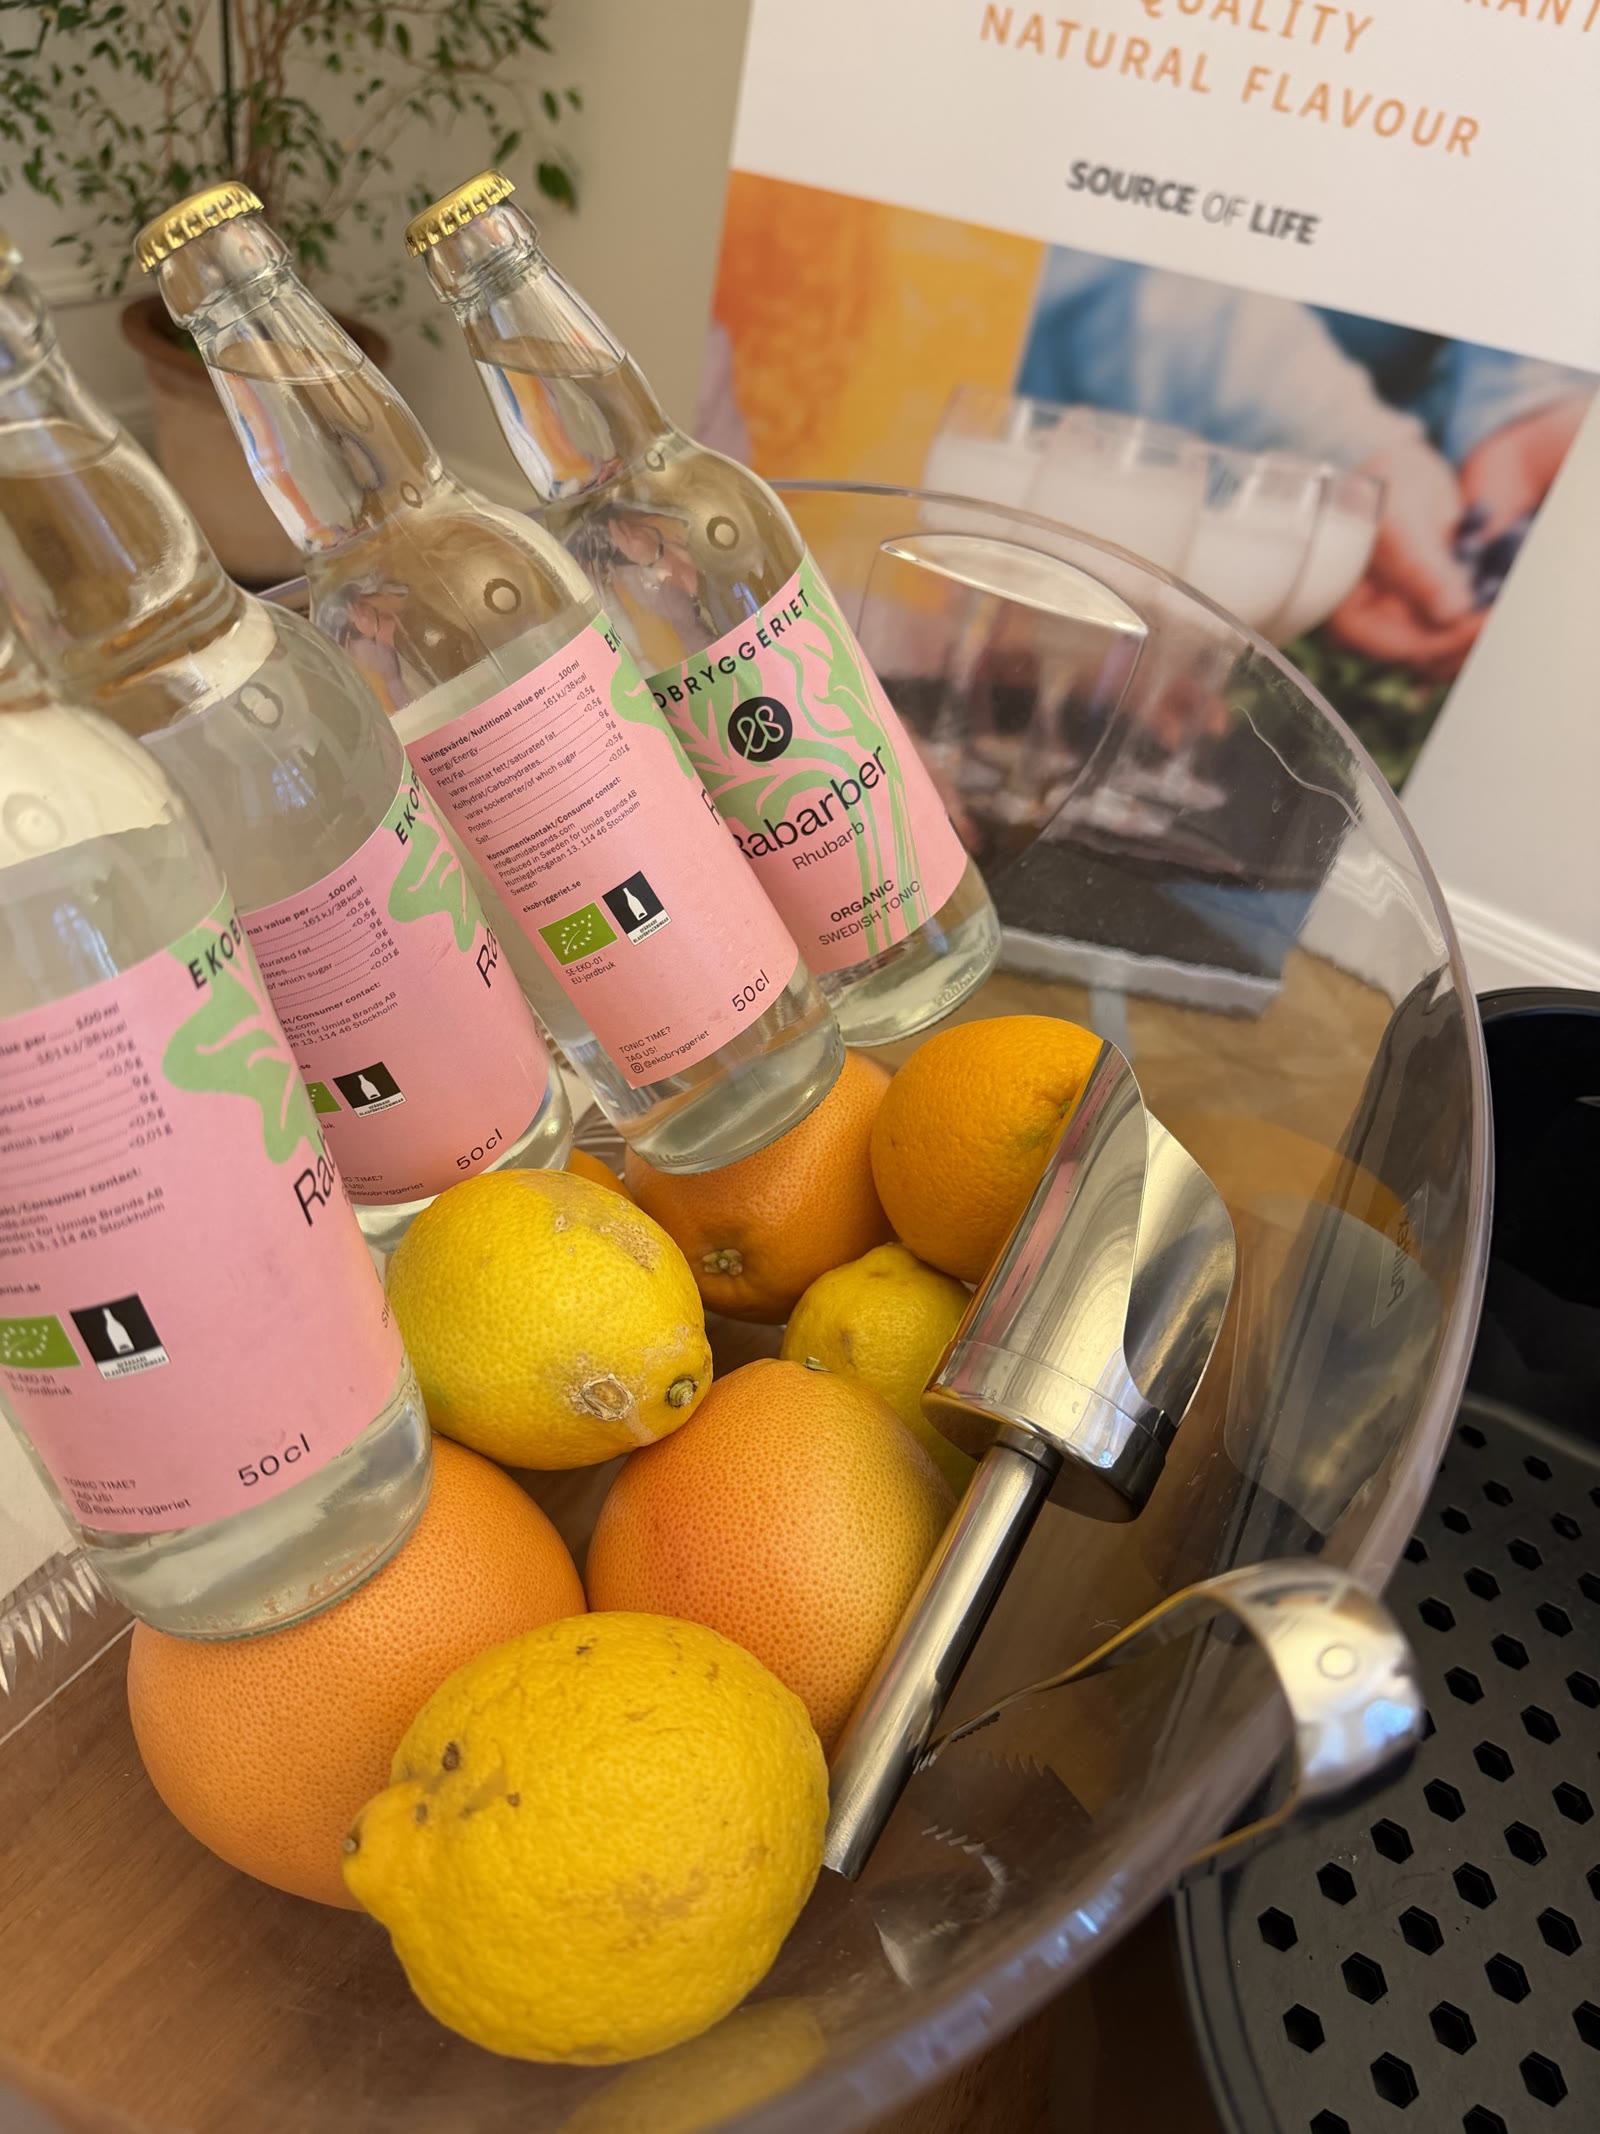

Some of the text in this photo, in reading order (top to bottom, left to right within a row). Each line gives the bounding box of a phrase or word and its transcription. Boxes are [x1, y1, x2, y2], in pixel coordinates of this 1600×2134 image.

[980, 4, 1481, 158] NATURAL FLAVOUR
[1066, 159, 1320, 246] SOURCE OF LIFE
[420, 708, 513, 763] Näringsvärde/Nutritional
[512, 696, 534, 713] value
[534, 686, 546, 699] per
[428, 747, 479, 775] Energi/Energy
[449, 785, 468, 797] varav
[469, 771, 493, 788] mättat
[492, 739, 545, 774] fett/saturated
[544, 731, 557, 742] fat
[437, 769, 466, 787] Fett/Fat
[452, 759, 541, 811] Kolhydrat/Carbohydrates
[464, 807, 484, 820] varav
[484, 777, 536, 811] sockerarter/of
[535, 764, 557, 781] which
[557, 751, 577, 768] sugar
[468, 818, 494, 833] Protein
[486, 776, 622, 861] Konsumentkontakt/Consumer contact:
[475, 834, 490, 845] Salt
[493, 822, 576, 870] info@umidabrands.com
[498, 789, 638, 879] Produced in Sweden for Umida Brands AB
[504, 801, 641, 888] Humlegårdsgatan 13, 114 46 Stockholm
[791, 821, 866, 871] Rhubarb
[510, 880, 539, 896] Sweden
[522, 880, 582, 913] ekobryggeriet.se
[830, 880, 894, 923] ORGANIC
[264, 916, 292, 931] value
[293, 907, 310, 921] per
[818, 881, 920, 946] SWEDISH TONIC
[297, 946, 312, 957] fat
[565, 956, 604, 977] SE-EKO-01
[278, 972, 306, 988] which
[307, 963, 333, 978] sugar
[571, 961, 616, 985] EU-jordbruk
[345, 981, 382, 1004] contact:
[301, 1038, 318, 1047] 13,
[319, 1031, 337, 1042] 114
[339, 1025, 352, 1035] 46
[352, 1001, 399, 1029] Stockholm
[307, 1028, 320, 1038] for
[321, 1017, 352, 1032] Umida
[352, 1001, 384, 1021] Brands
[384, 991, 397, 1003] AB
[24, 1034, 47, 1051] per
[619, 1026, 672, 1054] TONIC TIME?
[625, 1046, 658, 1063] TAG US!
[643, 1029, 710, 1069] @ekobryggeriet
[39, 1125, 74, 1144] sugar
[90, 1167, 142, 1194] contact:
[354, 1174, 384, 1182] TIME?
[36, 1225, 53, 1238] for
[56, 1215, 97, 1233] Umida
[99, 1197, 145, 1220] Brands
[147, 1186, 164, 1201] AB
[52, 1234, 76, 1249] 114
[80, 1229, 97, 1242] 46
[99, 1202, 165, 1235] Stockholm
[63, 1476, 136, 1491] TONIC TIME?
[72, 1489, 114, 1504] TAG US!
